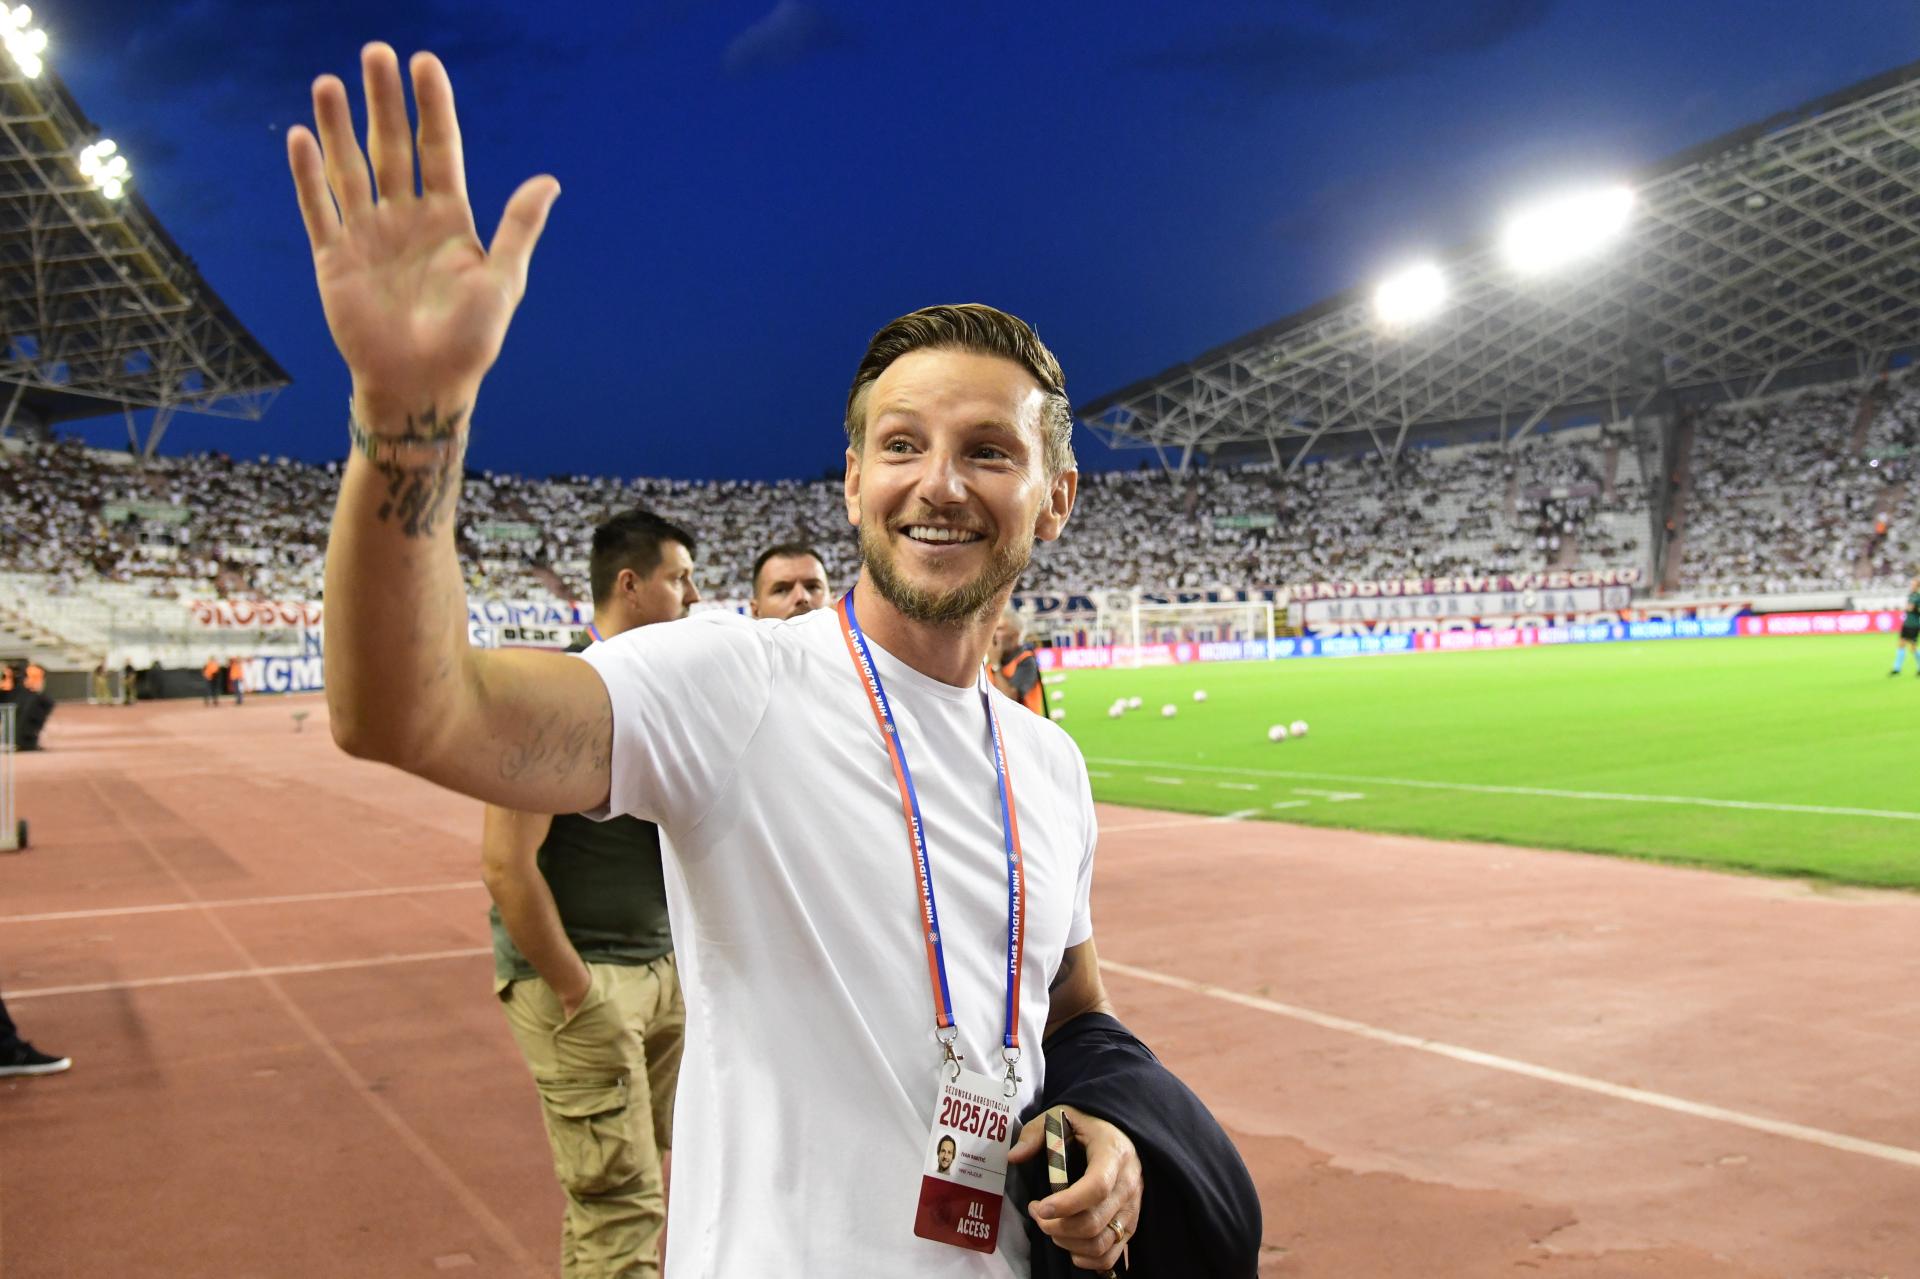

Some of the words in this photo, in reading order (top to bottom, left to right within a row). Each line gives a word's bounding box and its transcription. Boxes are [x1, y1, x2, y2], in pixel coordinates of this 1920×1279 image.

[848, 628, 864, 654] SPLIT
[858, 653, 880, 694] HAJDUK
[874, 695, 888, 717] HNK
[911, 815, 922, 847] SPLIT
[916, 849, 930, 896] HAJDUK
[1012, 870, 1021, 893] HNK
[925, 898, 935, 924] HNK
[1011, 896, 1021, 943] HAJDUK
[1010, 944, 1018, 976] SPLIT
[945, 1084, 972, 1100] SEZONSKA
[972, 1094, 1010, 1113] AKREDITACIJA
[939, 1096, 1008, 1143] 2025/26
[967, 1201, 984, 1220] ALL
[956, 1217, 991, 1239] ACCESS
